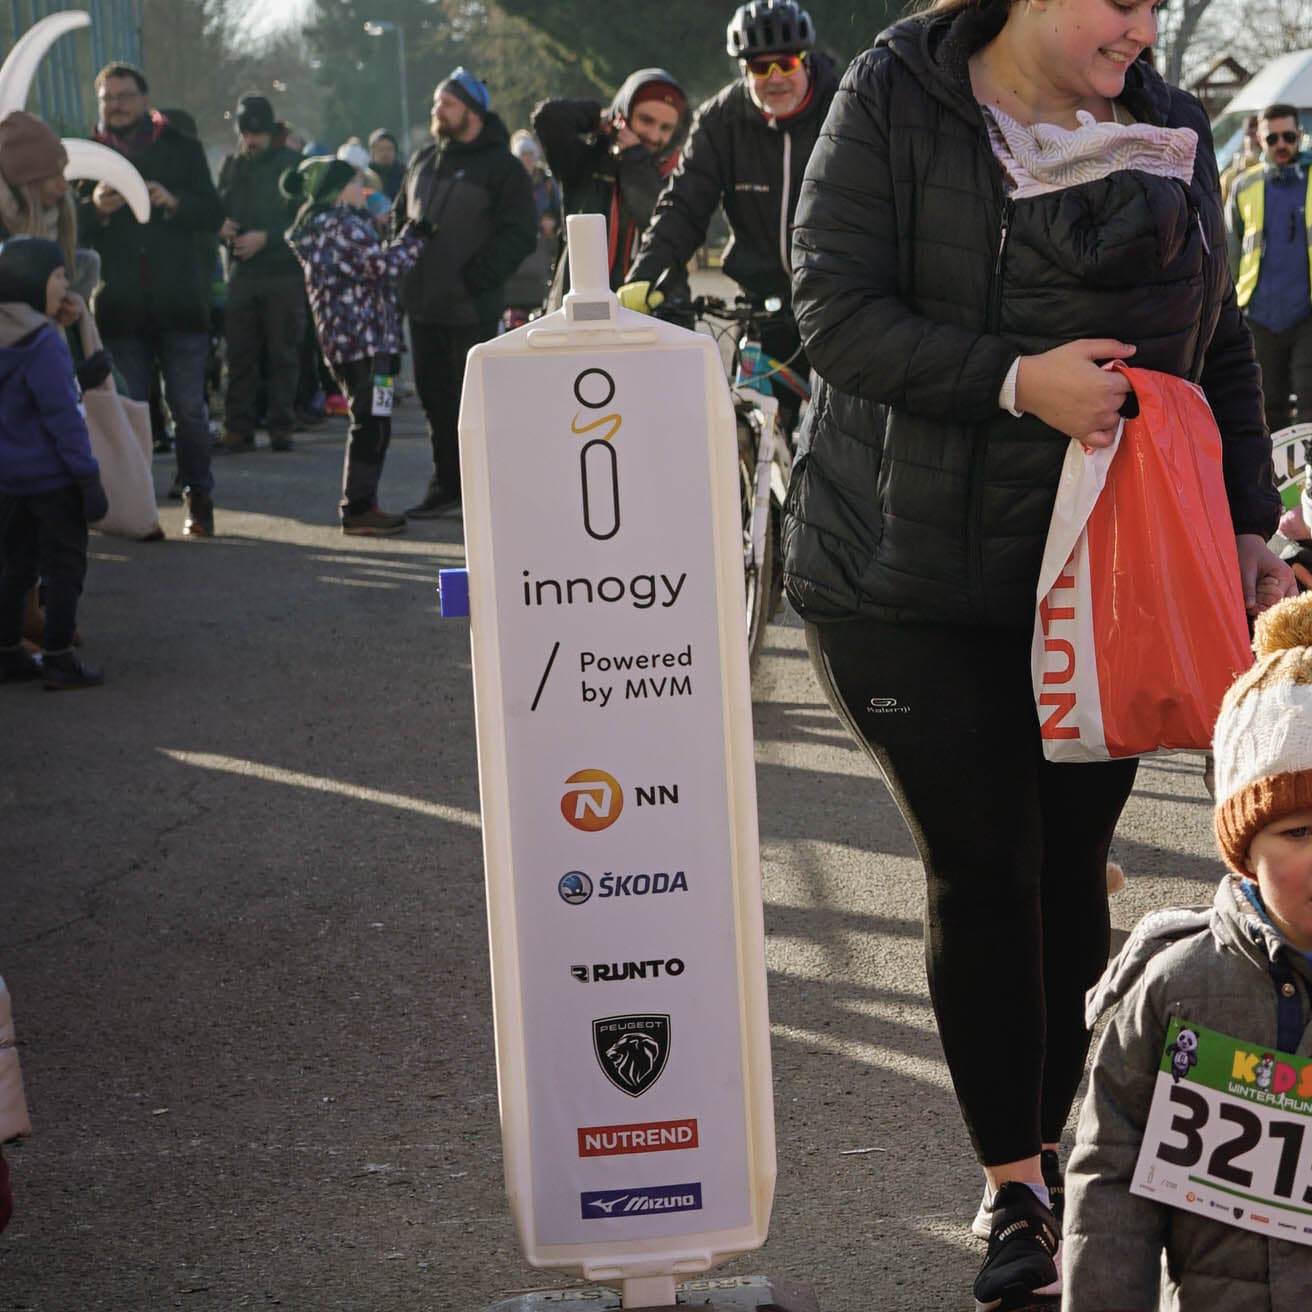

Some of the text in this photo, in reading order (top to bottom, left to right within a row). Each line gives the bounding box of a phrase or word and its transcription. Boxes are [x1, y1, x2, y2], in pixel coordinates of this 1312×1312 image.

[522, 570, 687, 609] innogy
[580, 645, 692, 673] Powered
[581, 677, 692, 708] by MVM
[636, 784, 680, 807] NN
[598, 871, 689, 899] ŠKODA
[592, 957, 685, 982] RUNTO
[600, 1020, 664, 1033] PEUGEOT
[585, 1125, 693, 1151] NUTREND
